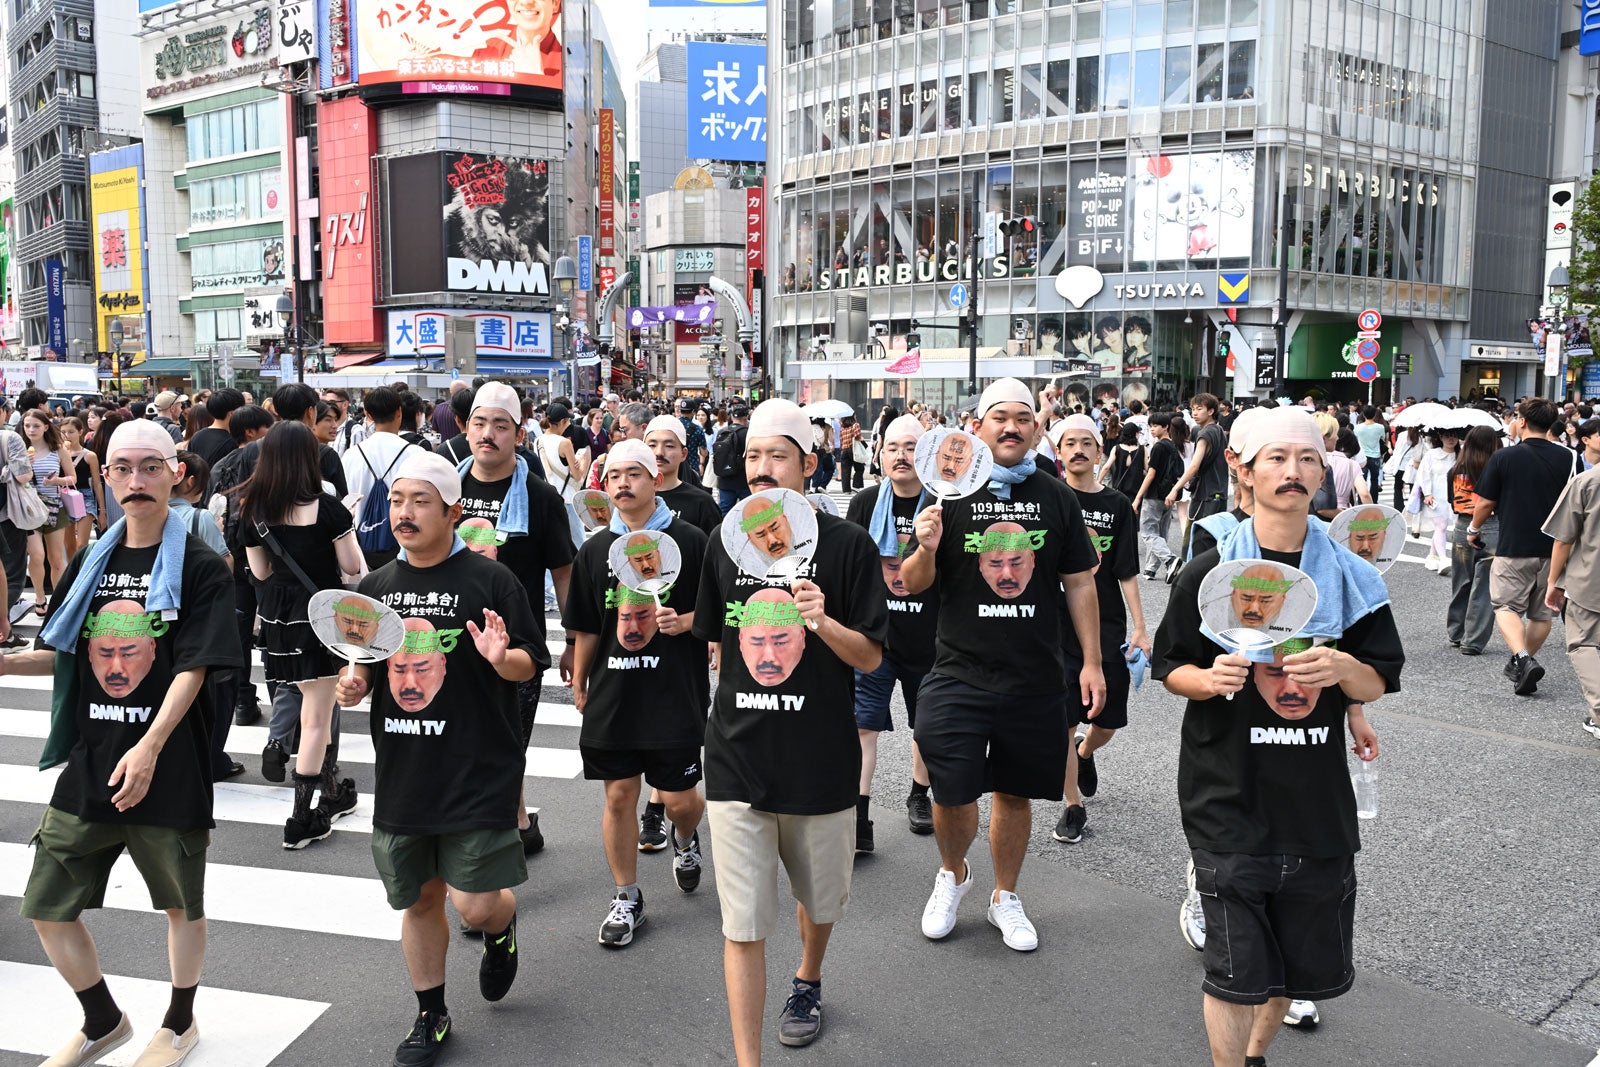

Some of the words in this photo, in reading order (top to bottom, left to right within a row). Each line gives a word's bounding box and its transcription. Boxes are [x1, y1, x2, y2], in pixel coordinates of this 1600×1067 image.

[279, 0, 313, 55] じゃ
[398, 58, 515, 77] 楽天ふるさと納税
[431, 83, 458, 92] Rakuten
[701, 61, 766, 106] 求人
[701, 112, 766, 142] ボック
[602, 112, 611, 193] クスリのことなら
[1303, 163, 1438, 206] STARBUCKS
[601, 200, 613, 249] 三千里
[748, 196, 761, 260] カラオケ
[1085, 214, 1118, 228] STORE
[327, 192, 368, 279] クスリ
[102, 228, 126, 268] 薬
[686, 250, 714, 259] れいわ
[676, 261, 714, 271] クリニック
[820, 256, 1007, 290] STARBUCKS
[447, 257, 549, 294] DMM
[1113, 282, 1205, 299] TSUTAYA
[396, 317, 539, 346] 大盛書店
[460, 497, 503, 511] 09前に集
[971, 502, 1041, 513] 109前に集合!
[462, 509, 500, 518] ローン発生中だ
[972, 513, 1041, 521] #クローン発生中だしん
[99, 573, 151, 587] 09前に集
[95, 588, 150, 598] クローン発生中
[381, 591, 459, 608] 109前に集合!
[391, 607, 456, 617] ーン発生中だしん
[725, 600, 807, 626] 大脱出
[886, 599, 907, 612] MM
[908, 602, 923, 613] TV
[978, 604, 1018, 617] DMM
[1019, 604, 1035, 617] TV
[725, 619, 738, 627] THE
[607, 656, 640, 669] DMM
[641, 656, 660, 668] TV
[736, 692, 779, 710] DMM
[781, 695, 805, 711] TV
[89, 702, 125, 722] DMM
[126, 706, 152, 723] TV
[384, 717, 421, 735] DMM
[422, 720, 446, 735] TV
[1250, 727, 1306, 744] DMM
[1308, 727, 1329, 744] TV
